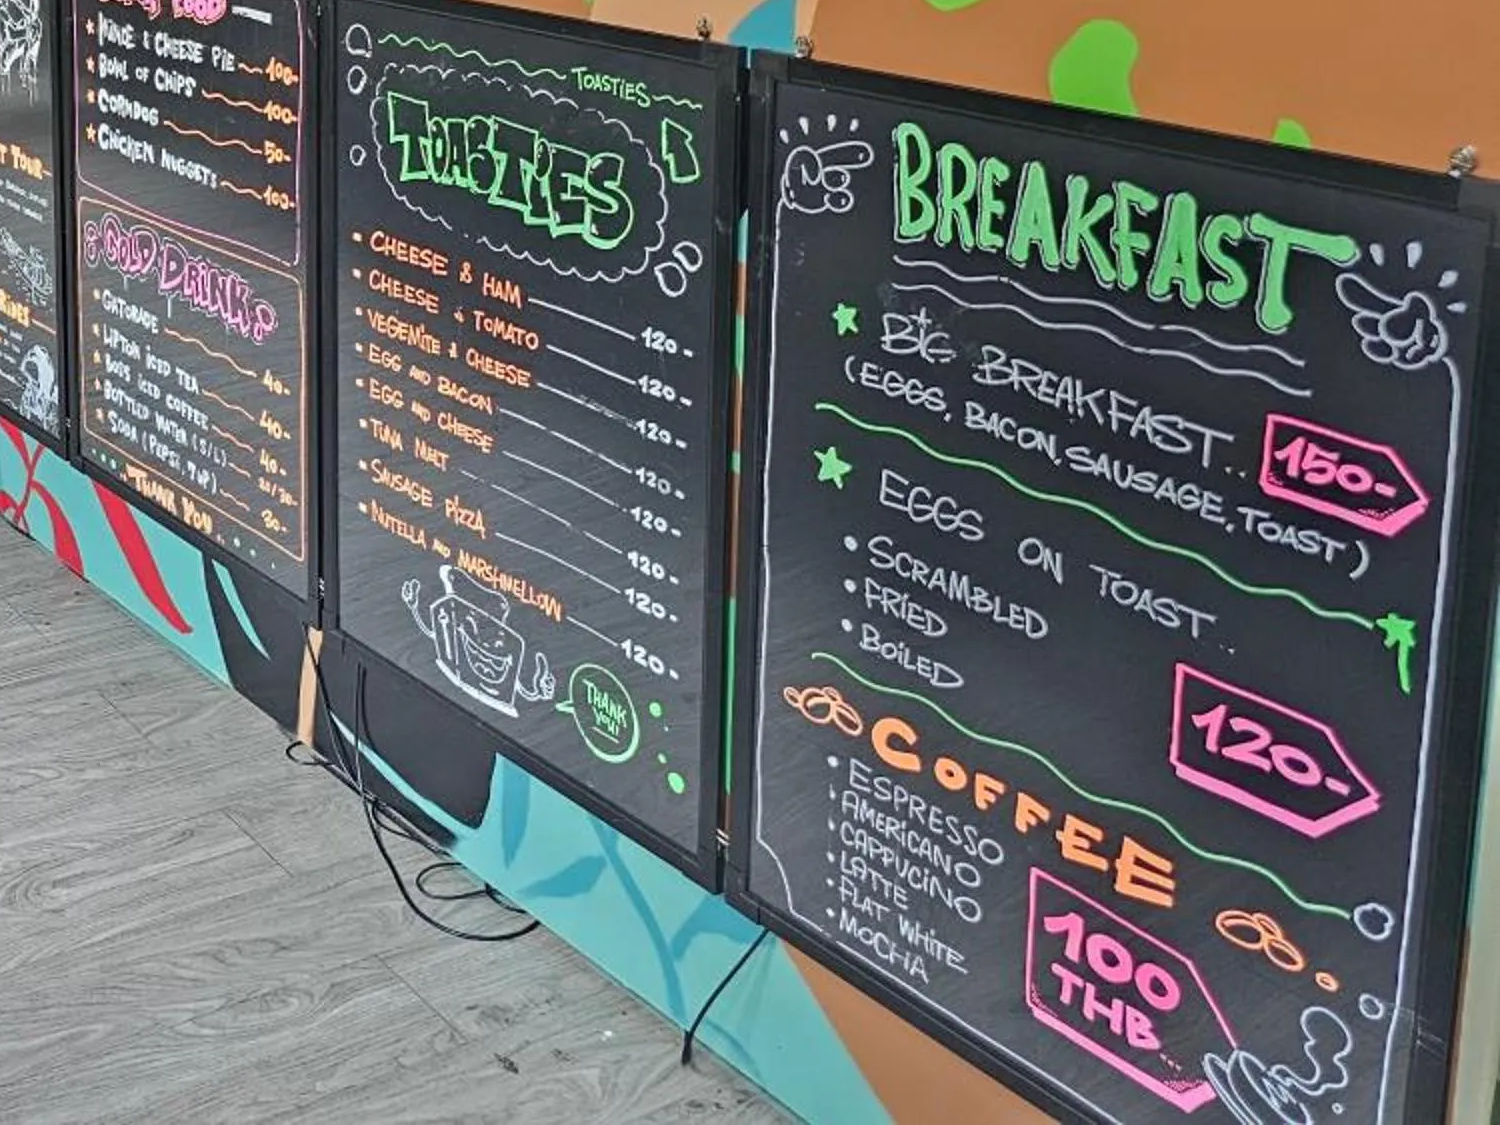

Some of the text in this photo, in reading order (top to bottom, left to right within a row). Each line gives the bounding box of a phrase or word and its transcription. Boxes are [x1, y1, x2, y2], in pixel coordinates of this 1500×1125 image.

[99, 52, 129, 81] BOWL
[136, 65, 150, 82] OF
[154, 66, 197, 98] CHIPS
[154, 30, 204, 65] CHEESE
[571, 67, 652, 108] TOASTIES
[98, 123, 155, 165] CHICKEN
[387, 91, 634, 250] TOASTIES
[891, 121, 1361, 336] BREAKFAST
[369, 230, 448, 276] CHEESE
[459, 261, 473, 284] &
[483, 272, 522, 310] HAM
[102, 288, 159, 334] GATORADE
[369, 269, 440, 315] CHEESE
[473, 310, 540, 350] TOMATO
[881, 307, 957, 363] BIG
[103, 323, 140, 360] LIPTON
[176, 366, 200, 395] TEA
[367, 308, 442, 357] VEGEMITE
[465, 348, 532, 388] CHEESE
[368, 342, 402, 372] EGG
[437, 376, 494, 416] BACON
[108, 410, 138, 444] SODA
[155, 411, 188, 446] WATER
[166, 394, 209, 431] COFFEE
[368, 378, 404, 409] EGG
[437, 412, 494, 453] CHEESE
[369, 418, 404, 451] TUNA
[126, 463, 177, 516] THANK
[370, 458, 433, 508] SAUSAGE
[444, 495, 486, 540] PIZZA
[371, 498, 427, 550] NUTELLA
[879, 469, 985, 542] EGGS
[1018, 537, 1064, 585] ON
[863, 578, 949, 639] FRIED
[868, 536, 1049, 640] SCRAMBLED
[859, 623, 964, 690] BOILED
[582, 678, 627, 729] THANK
[841, 791, 982, 887] AMERICANO
[849, 758, 1004, 865] ESPRESSO
[871, 718, 1176, 908] COFFEE
[840, 821, 982, 923] CAPPUCINO
[840, 851, 909, 910] LATTE
[839, 875, 969, 974] FLAT WHITE
[839, 907, 930, 984] MOCHA
[1044, 912, 1181, 1011] 100
